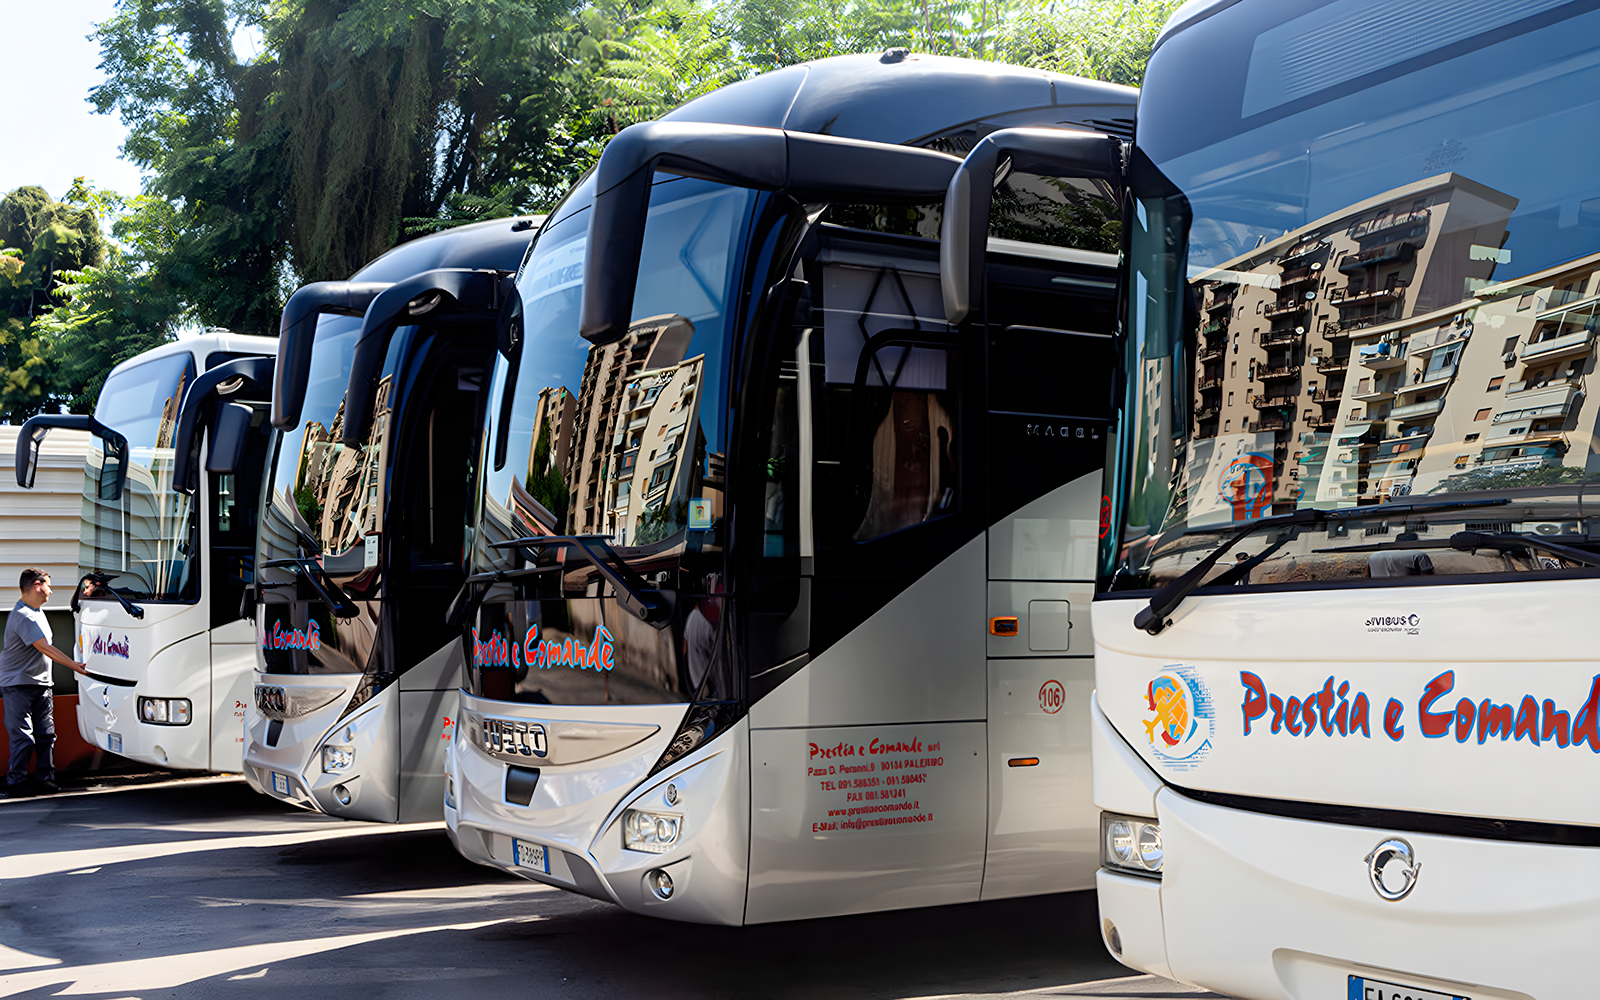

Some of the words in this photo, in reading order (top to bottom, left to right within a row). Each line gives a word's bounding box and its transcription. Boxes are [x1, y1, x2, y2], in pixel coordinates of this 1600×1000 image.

[511, 641, 521, 669] e
[523, 622, 615, 673] Comandè
[1042, 687, 1060, 708] 106
[1239, 670, 1372, 739] Prestia
[1383, 696, 1405, 742] e
[808, 741, 855, 760] Prestia
[858, 745, 865, 757] e
